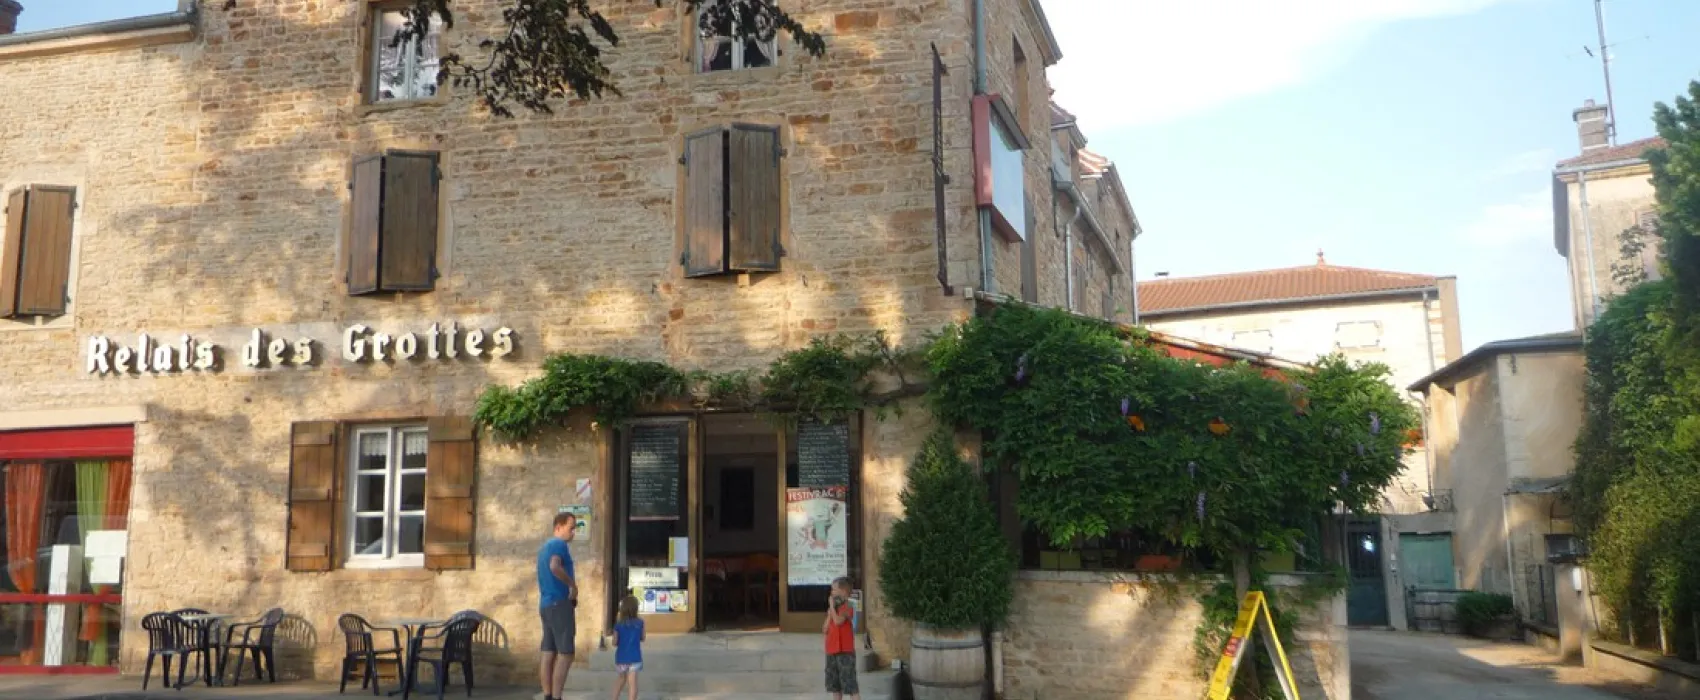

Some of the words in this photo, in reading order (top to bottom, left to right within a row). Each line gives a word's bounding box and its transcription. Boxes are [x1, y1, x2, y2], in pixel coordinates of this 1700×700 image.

[86, 333, 217, 374] Relais
[241, 327, 314, 366] des
[342, 322, 515, 363] Grottes
